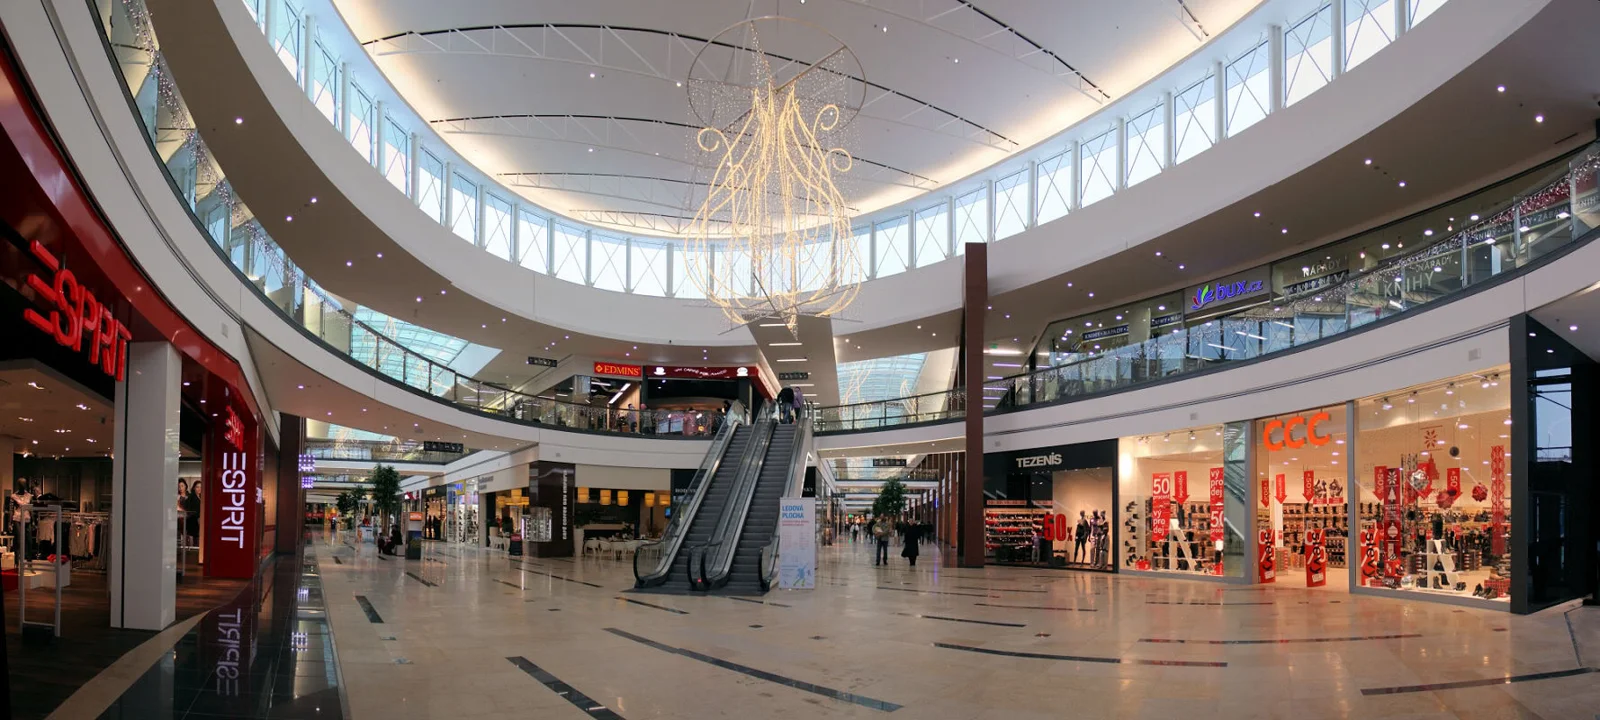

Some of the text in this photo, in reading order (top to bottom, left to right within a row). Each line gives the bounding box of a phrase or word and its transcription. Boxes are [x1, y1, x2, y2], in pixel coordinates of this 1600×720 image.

[1216, 280, 1264, 301] bux.cz
[1384, 271, 1434, 298] KNIHY
[24, 240, 132, 382] ESPRIT
[604, 365, 639, 376] EDMINS
[1263, 411, 1332, 452] CCC
[1016, 452, 1063, 468] TEZENIS
[1211, 469, 1220, 480] vý
[1153, 478, 1170, 495] 50
[1210, 479, 1224, 489] pro
[221, 452, 246, 549] ESPRIT
[1210, 487, 1223, 498] dej
[1153, 509, 1162, 518] vý
[1153, 518, 1165, 526] pro
[1153, 526, 1165, 536] dej
[1310, 532, 1322, 574] slevy
[1363, 532, 1375, 578] slevy
